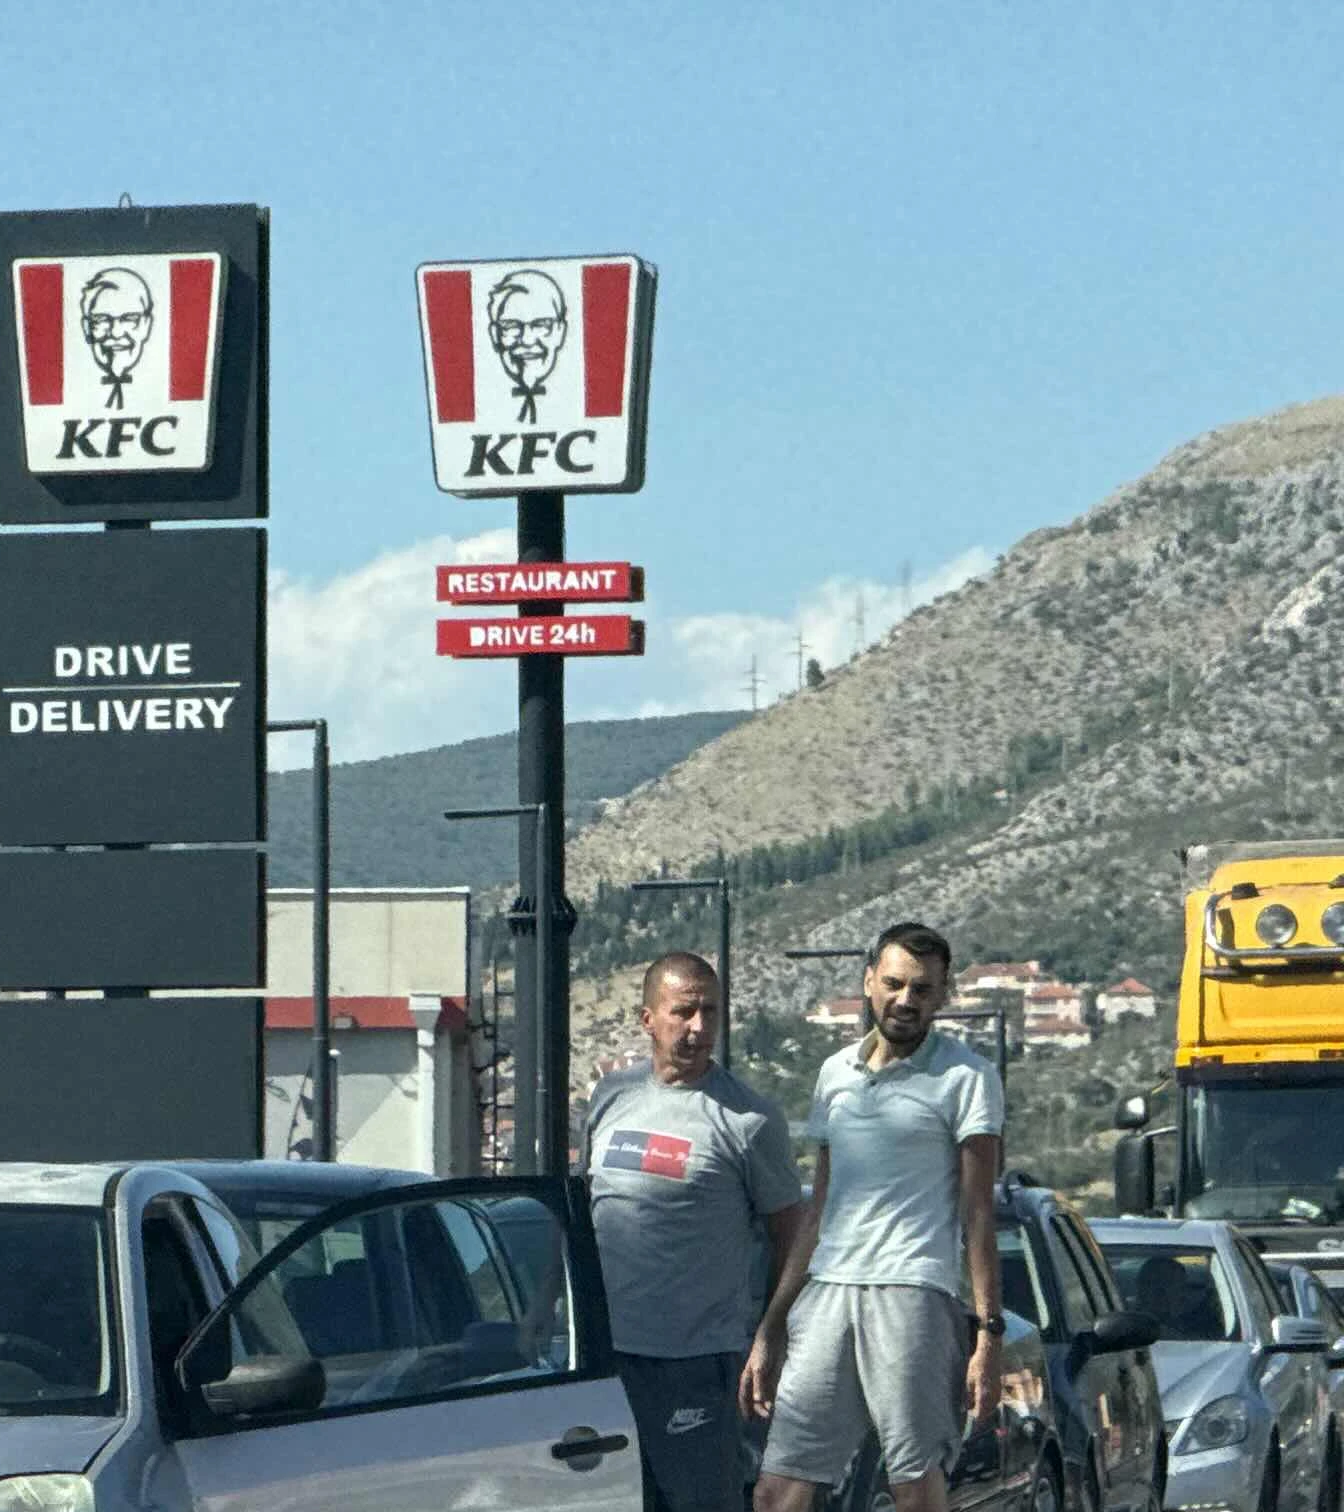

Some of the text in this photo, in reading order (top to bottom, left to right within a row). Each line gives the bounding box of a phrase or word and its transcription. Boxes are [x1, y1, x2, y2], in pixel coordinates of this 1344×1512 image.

[55, 415, 179, 460] KFC
[463, 429, 598, 478] KFC
[447, 569, 617, 594] RESTAURANT
[468, 622, 596, 647] DRIVE 24h
[54, 643, 193, 678] DRIVE
[10, 697, 234, 734] DELIVERY
